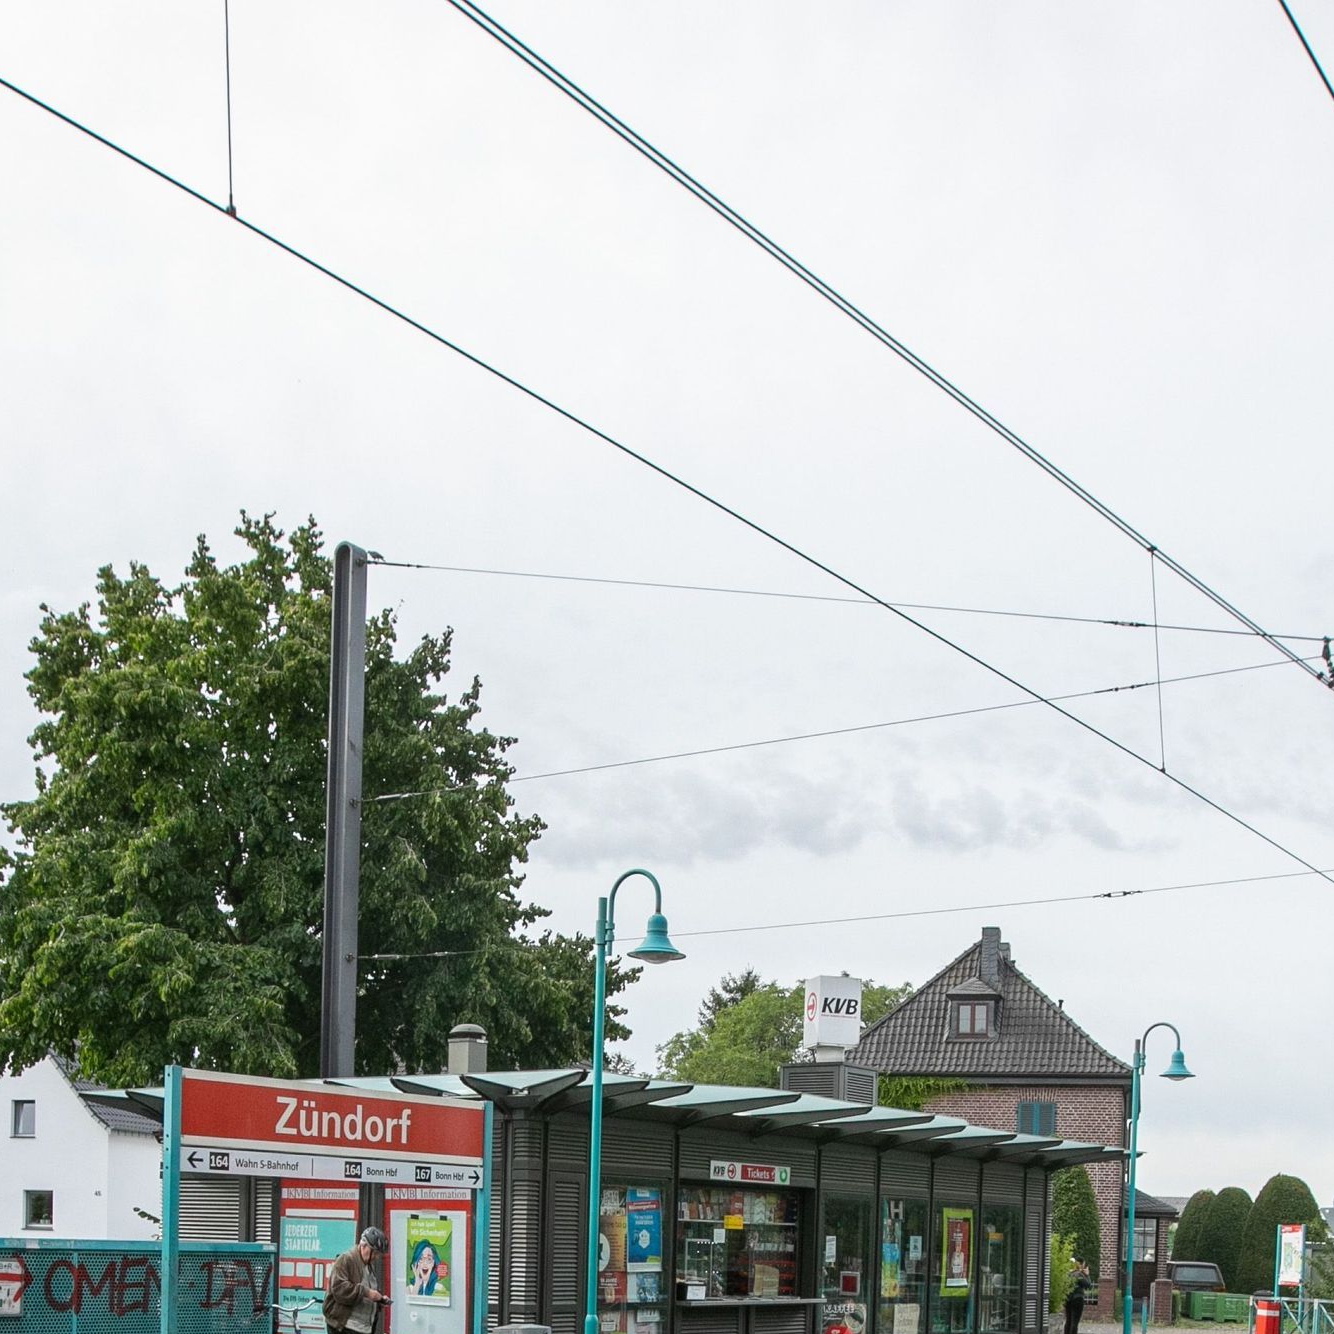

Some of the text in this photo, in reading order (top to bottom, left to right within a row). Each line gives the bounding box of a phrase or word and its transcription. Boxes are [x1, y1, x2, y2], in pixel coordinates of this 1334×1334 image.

[821, 997, 859, 1015] KVB
[275, 1096, 411, 1144] Zündorf
[210, 1155, 299, 1172] 164 Wahn S-Bahnhof
[345, 1164, 398, 1178] 164 Bonn Hbf
[416, 1168, 465, 1182] 167 Bonn Hbf
[713, 1166, 725, 1175] KVB
[746, 1167, 769, 1179] Tickets
[313, 1188, 356, 1199] Information
[420, 1188, 467, 1199] Information
[285, 1225, 319, 1238] JEDERZEIT
